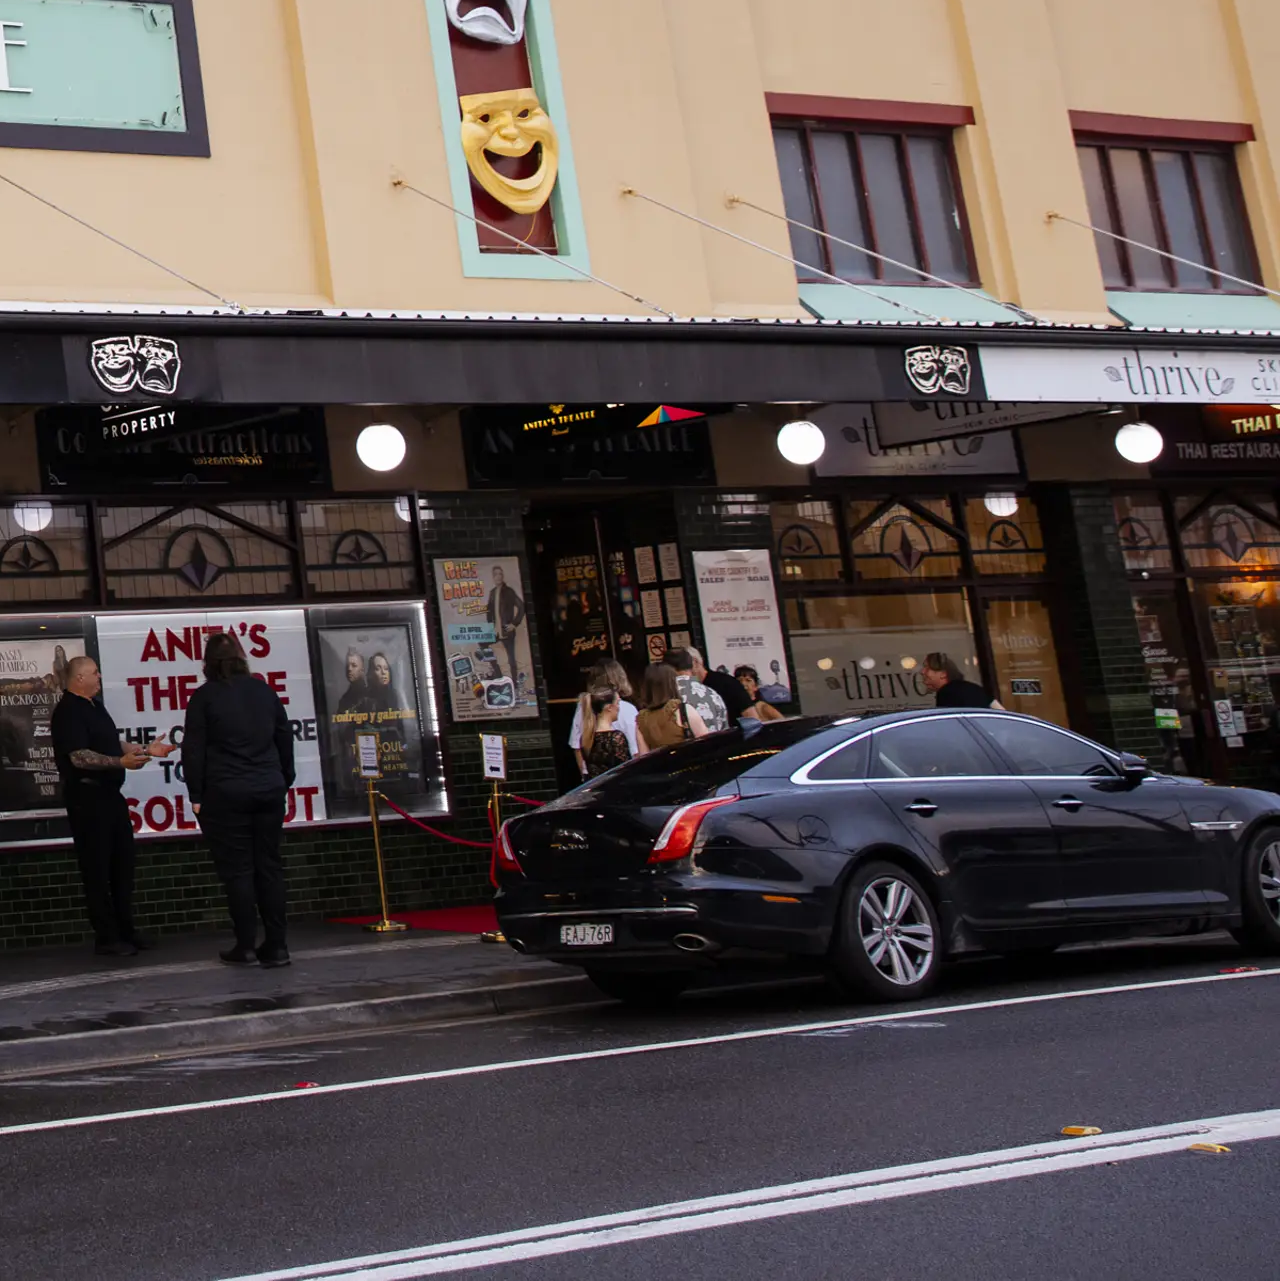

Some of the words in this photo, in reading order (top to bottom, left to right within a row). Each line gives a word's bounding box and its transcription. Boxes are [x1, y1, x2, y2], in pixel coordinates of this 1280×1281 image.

[1121, 347, 1224, 396] thrive
[101, 410, 177, 440] PROPERTY
[523, 416, 557, 431] ANITA'S
[558, 409, 597, 424] THEATRE
[1231, 414, 1272, 435] THAI
[1176, 443, 1207, 460] THAI
[443, 580, 484, 601] DARBY
[0, 693, 49, 707] BACKBONE
[332, 709, 368, 724] rodrigo
